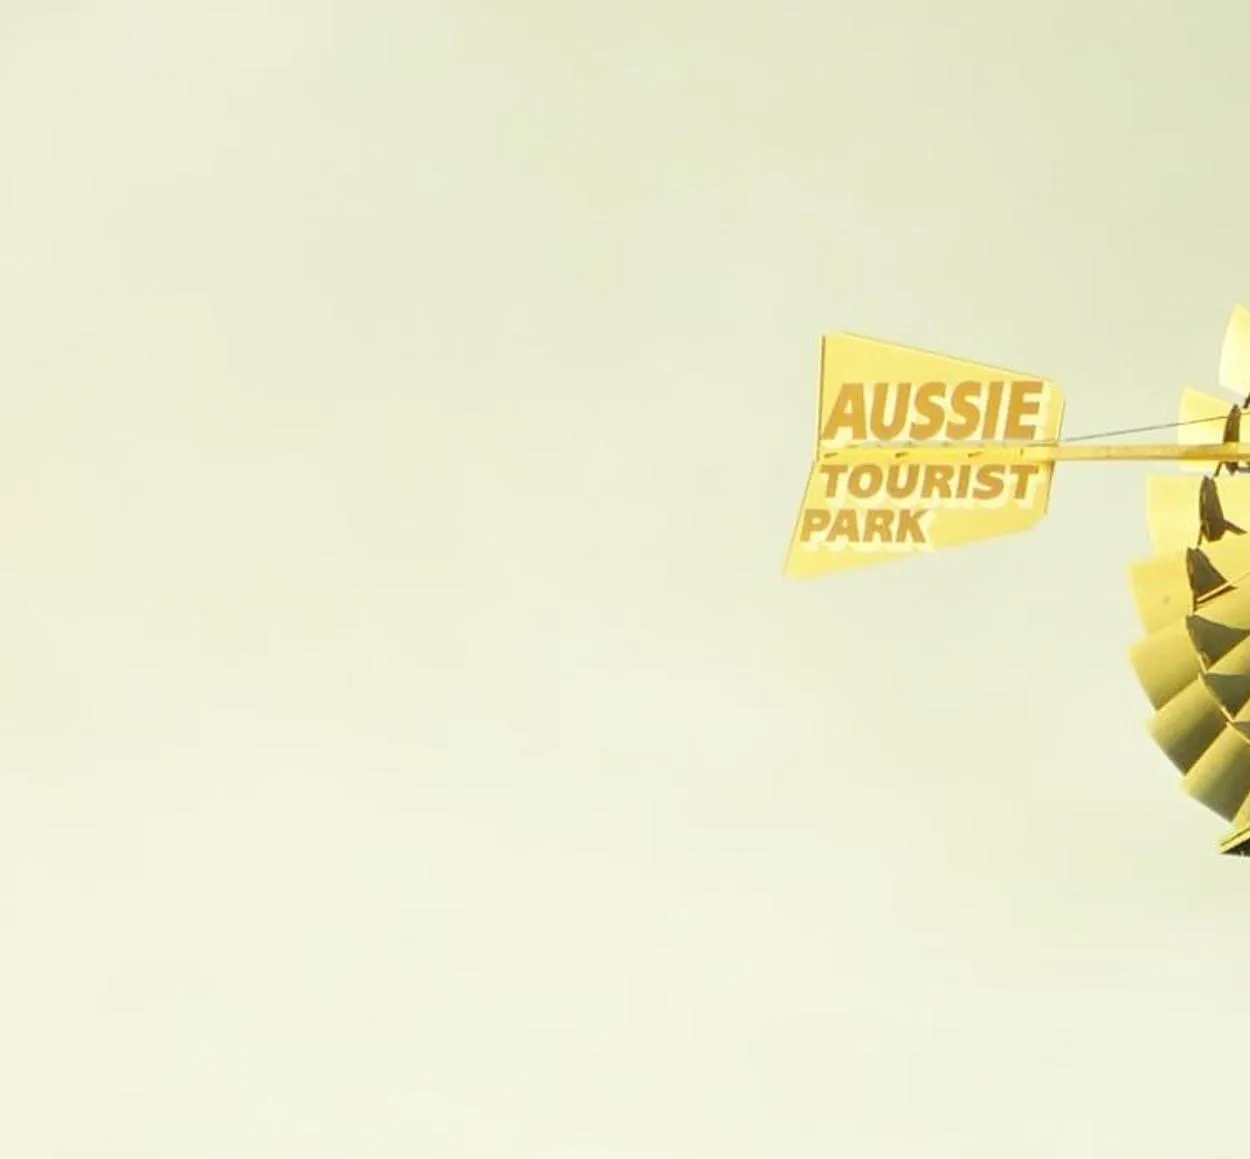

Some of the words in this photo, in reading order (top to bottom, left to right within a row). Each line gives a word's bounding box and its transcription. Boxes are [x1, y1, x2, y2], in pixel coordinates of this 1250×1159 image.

[822, 381, 1043, 440] AUSSIE
[819, 464, 1039, 499] TOURIST
[800, 509, 929, 543] PARK
